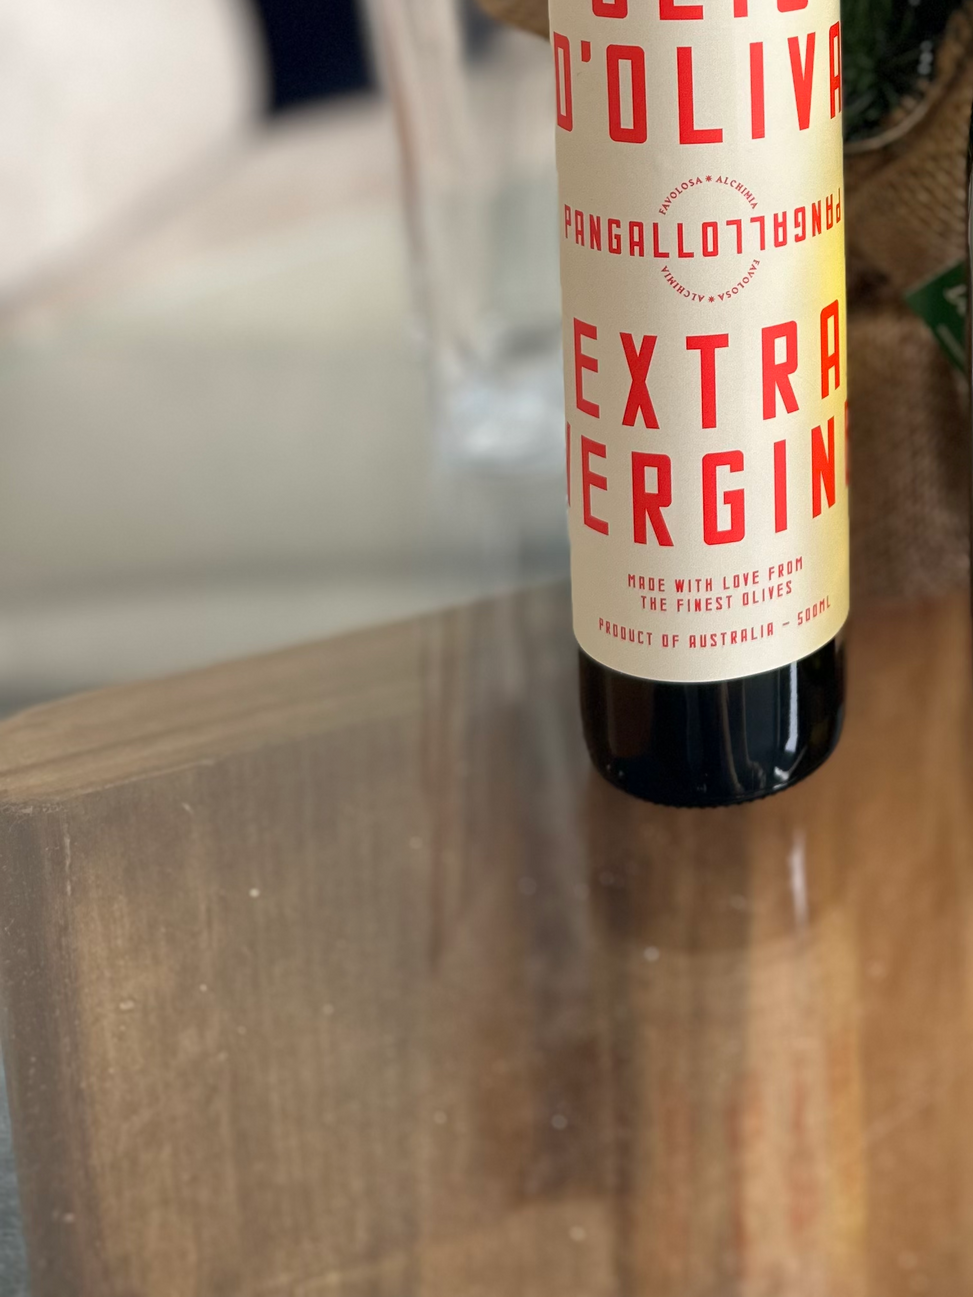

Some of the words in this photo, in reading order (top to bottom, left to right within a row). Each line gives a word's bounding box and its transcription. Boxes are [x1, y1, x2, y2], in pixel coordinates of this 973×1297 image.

[553, 20, 842, 145] D'OLIVA
[658, 176, 703, 215] FAVOLOSA
[715, 175, 758, 209] ALCHIMIA
[661, 265, 705, 303] ALCHIMIA
[718, 259, 760, 302] FAVOLOSA
[573, 299, 840, 430] EXTRA
[627, 573, 665, 593] MADE
[674, 577, 713, 594] WITH
[722, 570, 759, 592] LOVE
[768, 556, 803, 581] FROM
[640, 595, 667, 613] THE
[676, 596, 732, 613] FINEST
[742, 580, 792, 607] OLIVES
[598, 617, 653, 646] PRODUCT
[661, 633, 680, 649] OF
[688, 622, 774, 649] AUSTRALIA
[797, 595, 831, 626] 500ML
